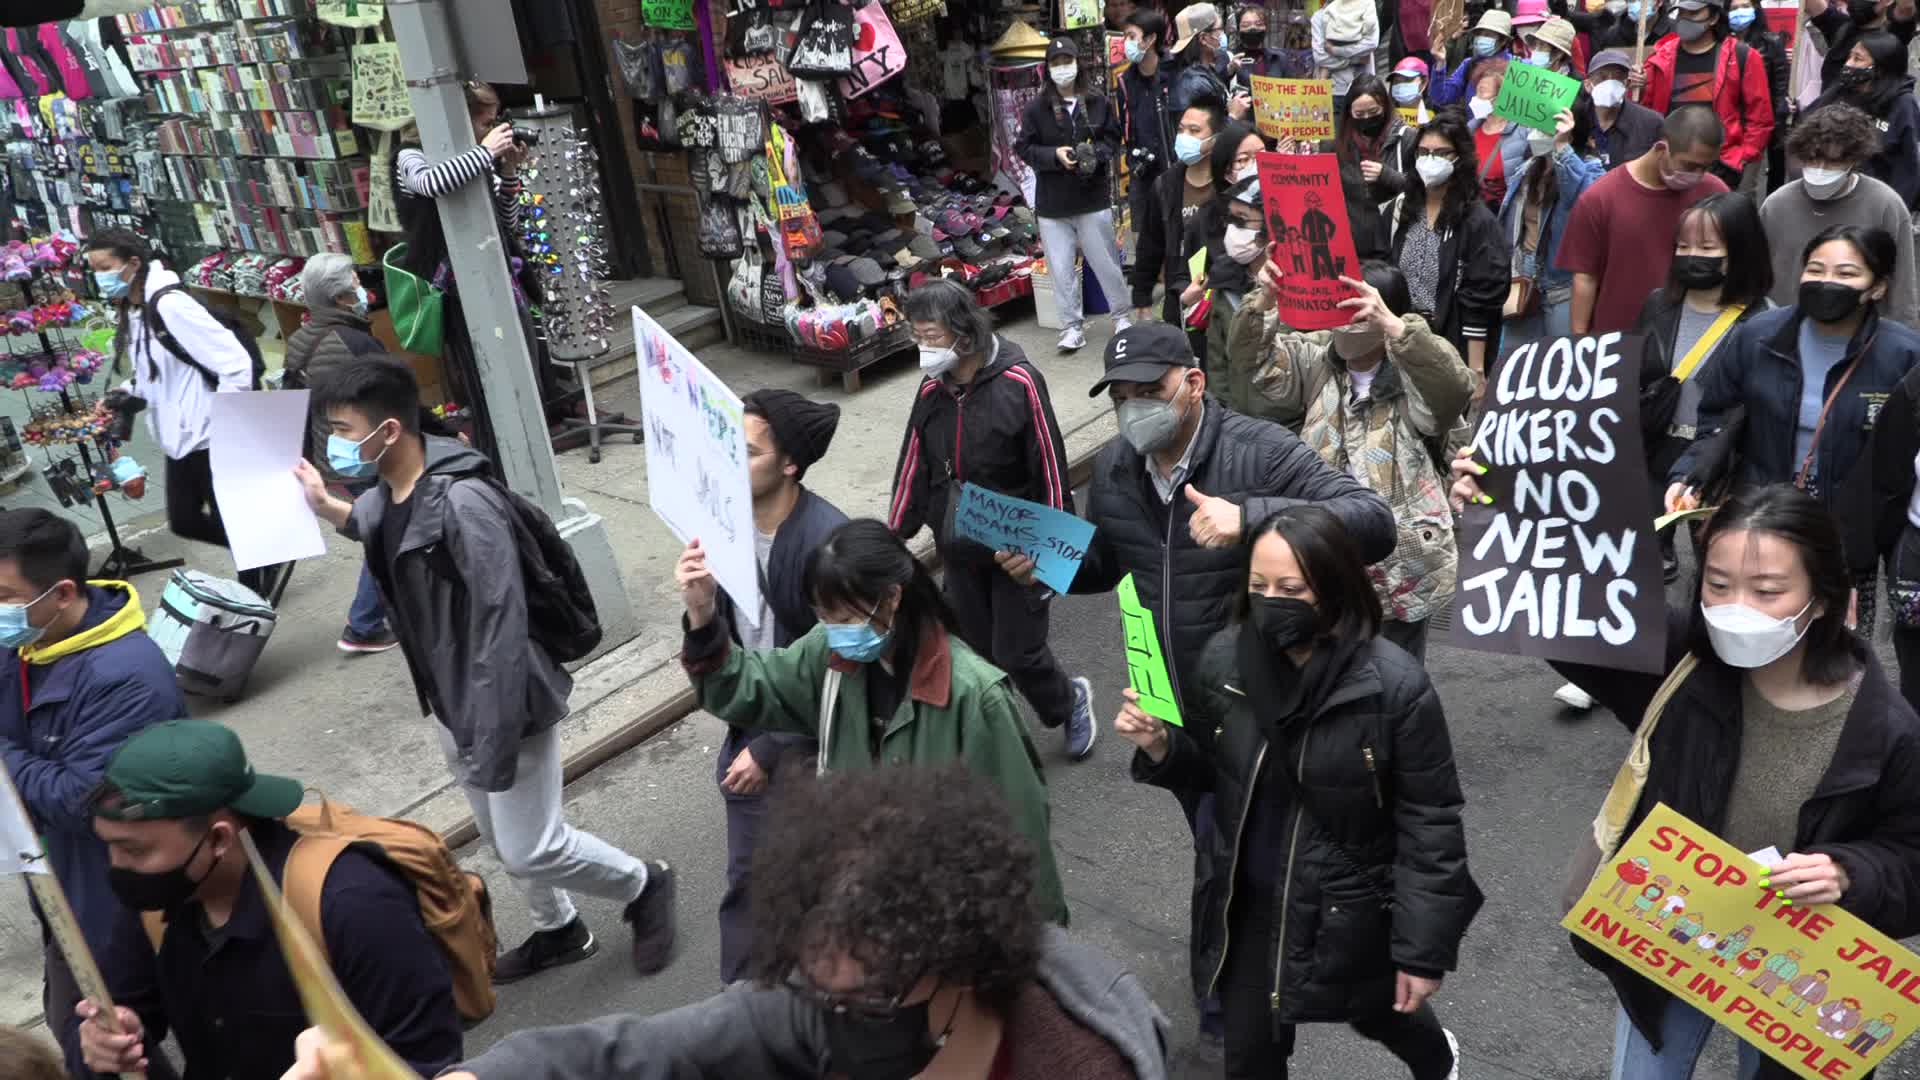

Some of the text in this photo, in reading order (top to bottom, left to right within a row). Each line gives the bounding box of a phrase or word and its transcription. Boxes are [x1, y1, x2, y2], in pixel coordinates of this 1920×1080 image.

[1253, 81, 1327, 96] STOP THE JAIL
[1507, 67, 1568, 100] NO NEW
[1498, 92, 1547, 122] JAILS
[1292, 127, 1330, 137] PEOPLE
[1272, 174, 1329, 187] COMMUNITY
[1496, 331, 1621, 405] CLOSE
[1471, 407, 1621, 465] RIKERS
[968, 490, 1040, 521] MAYOR
[1514, 468, 1600, 522] NO
[1047, 536, 1084, 560] STOP
[1473, 512, 1637, 577] NEW
[1462, 567, 1638, 645] JAILS
[1649, 826, 1920, 1005] STOP THE JAIL
[1580, 907, 1852, 1080] INVEST IN PEOPLE
